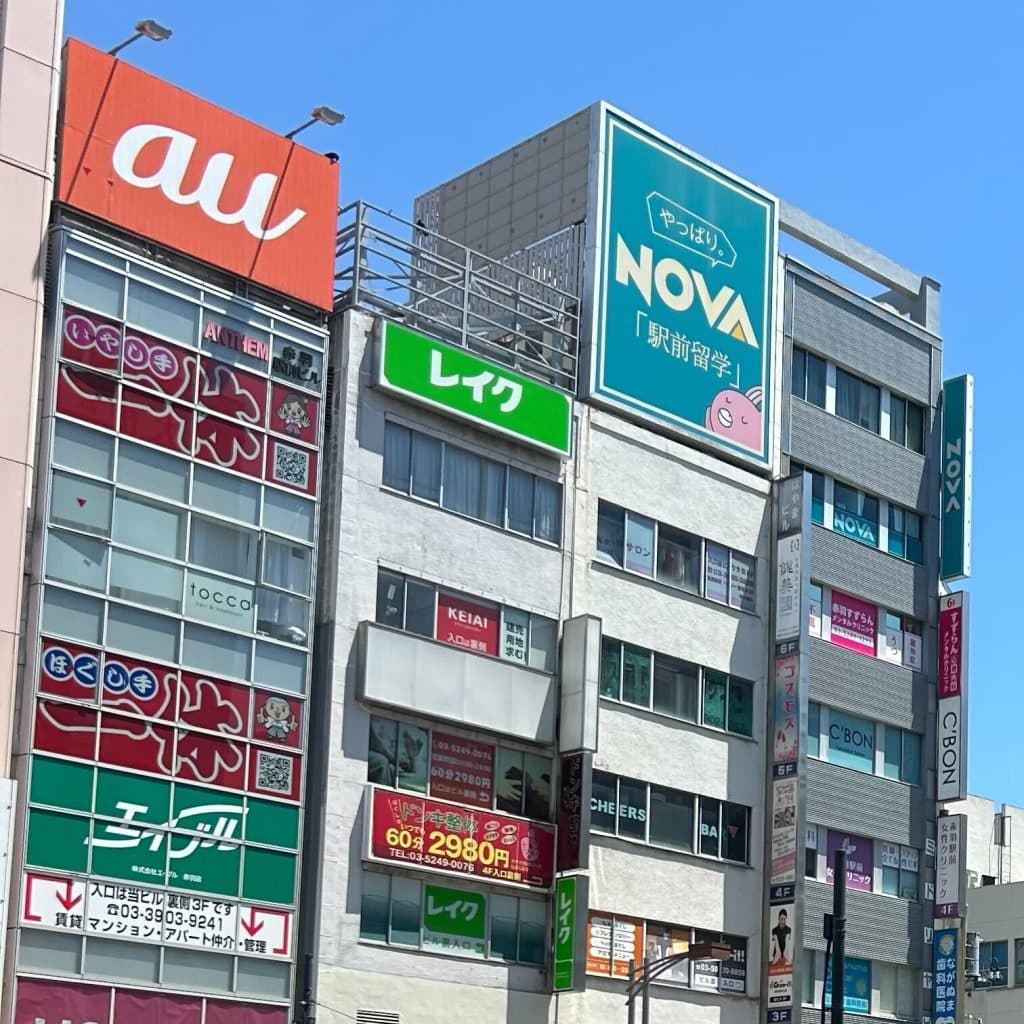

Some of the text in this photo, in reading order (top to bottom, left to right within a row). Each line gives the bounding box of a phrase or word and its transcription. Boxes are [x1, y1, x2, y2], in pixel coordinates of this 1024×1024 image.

[111, 124, 306, 240] au
[615, 231, 760, 349] NOVA
[430, 349, 524, 413] レイク
[945, 438, 961, 512] NOVA
[834, 511, 875, 544] NOVA
[190, 581, 252, 611] tocco
[447, 607, 488, 630] KEIAI
[829, 723, 873, 750] C'BON
[943, 710, 957, 785] C'BON
[590, 797, 646, 822] CHEERS
[84, 800, 249, 859] エイブル
[386, 828, 424, 850] 60分
[388, 847, 475, 873] TEL:03-5249-0076
[429, 830, 510, 869] 2980円
[121, 902, 223, 932] 03-3903-9241
[427, 895, 478, 921] レイク
[559, 892, 571, 945] レイク
[772, 1011, 787, 1022] 3F
